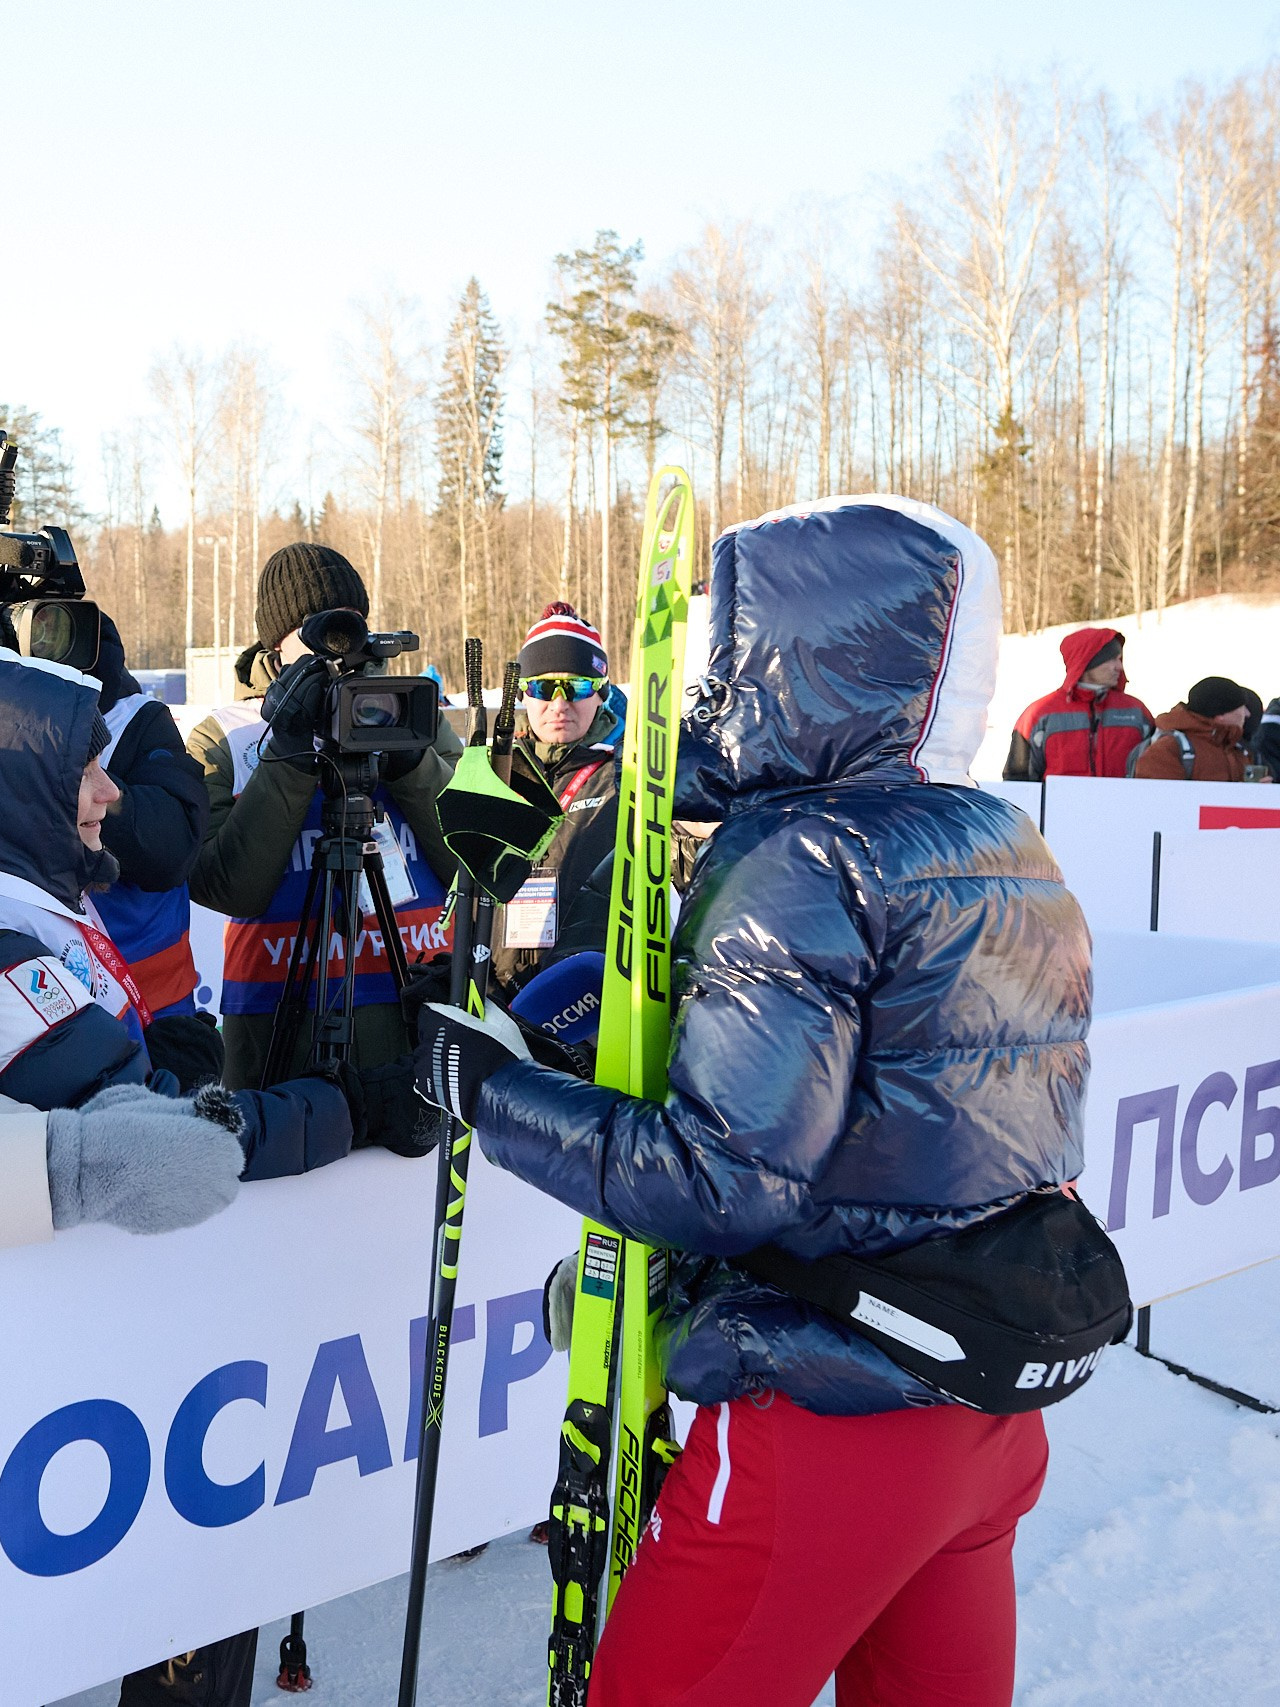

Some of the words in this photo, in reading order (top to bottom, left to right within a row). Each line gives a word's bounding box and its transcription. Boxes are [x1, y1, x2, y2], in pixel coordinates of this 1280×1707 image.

[646, 671, 668, 1003] FISCHER
[541, 992, 600, 1034] ОССИЯ
[601, 1238, 618, 1248] RUS
[433, 1324, 448, 1398] BLACKCODE
